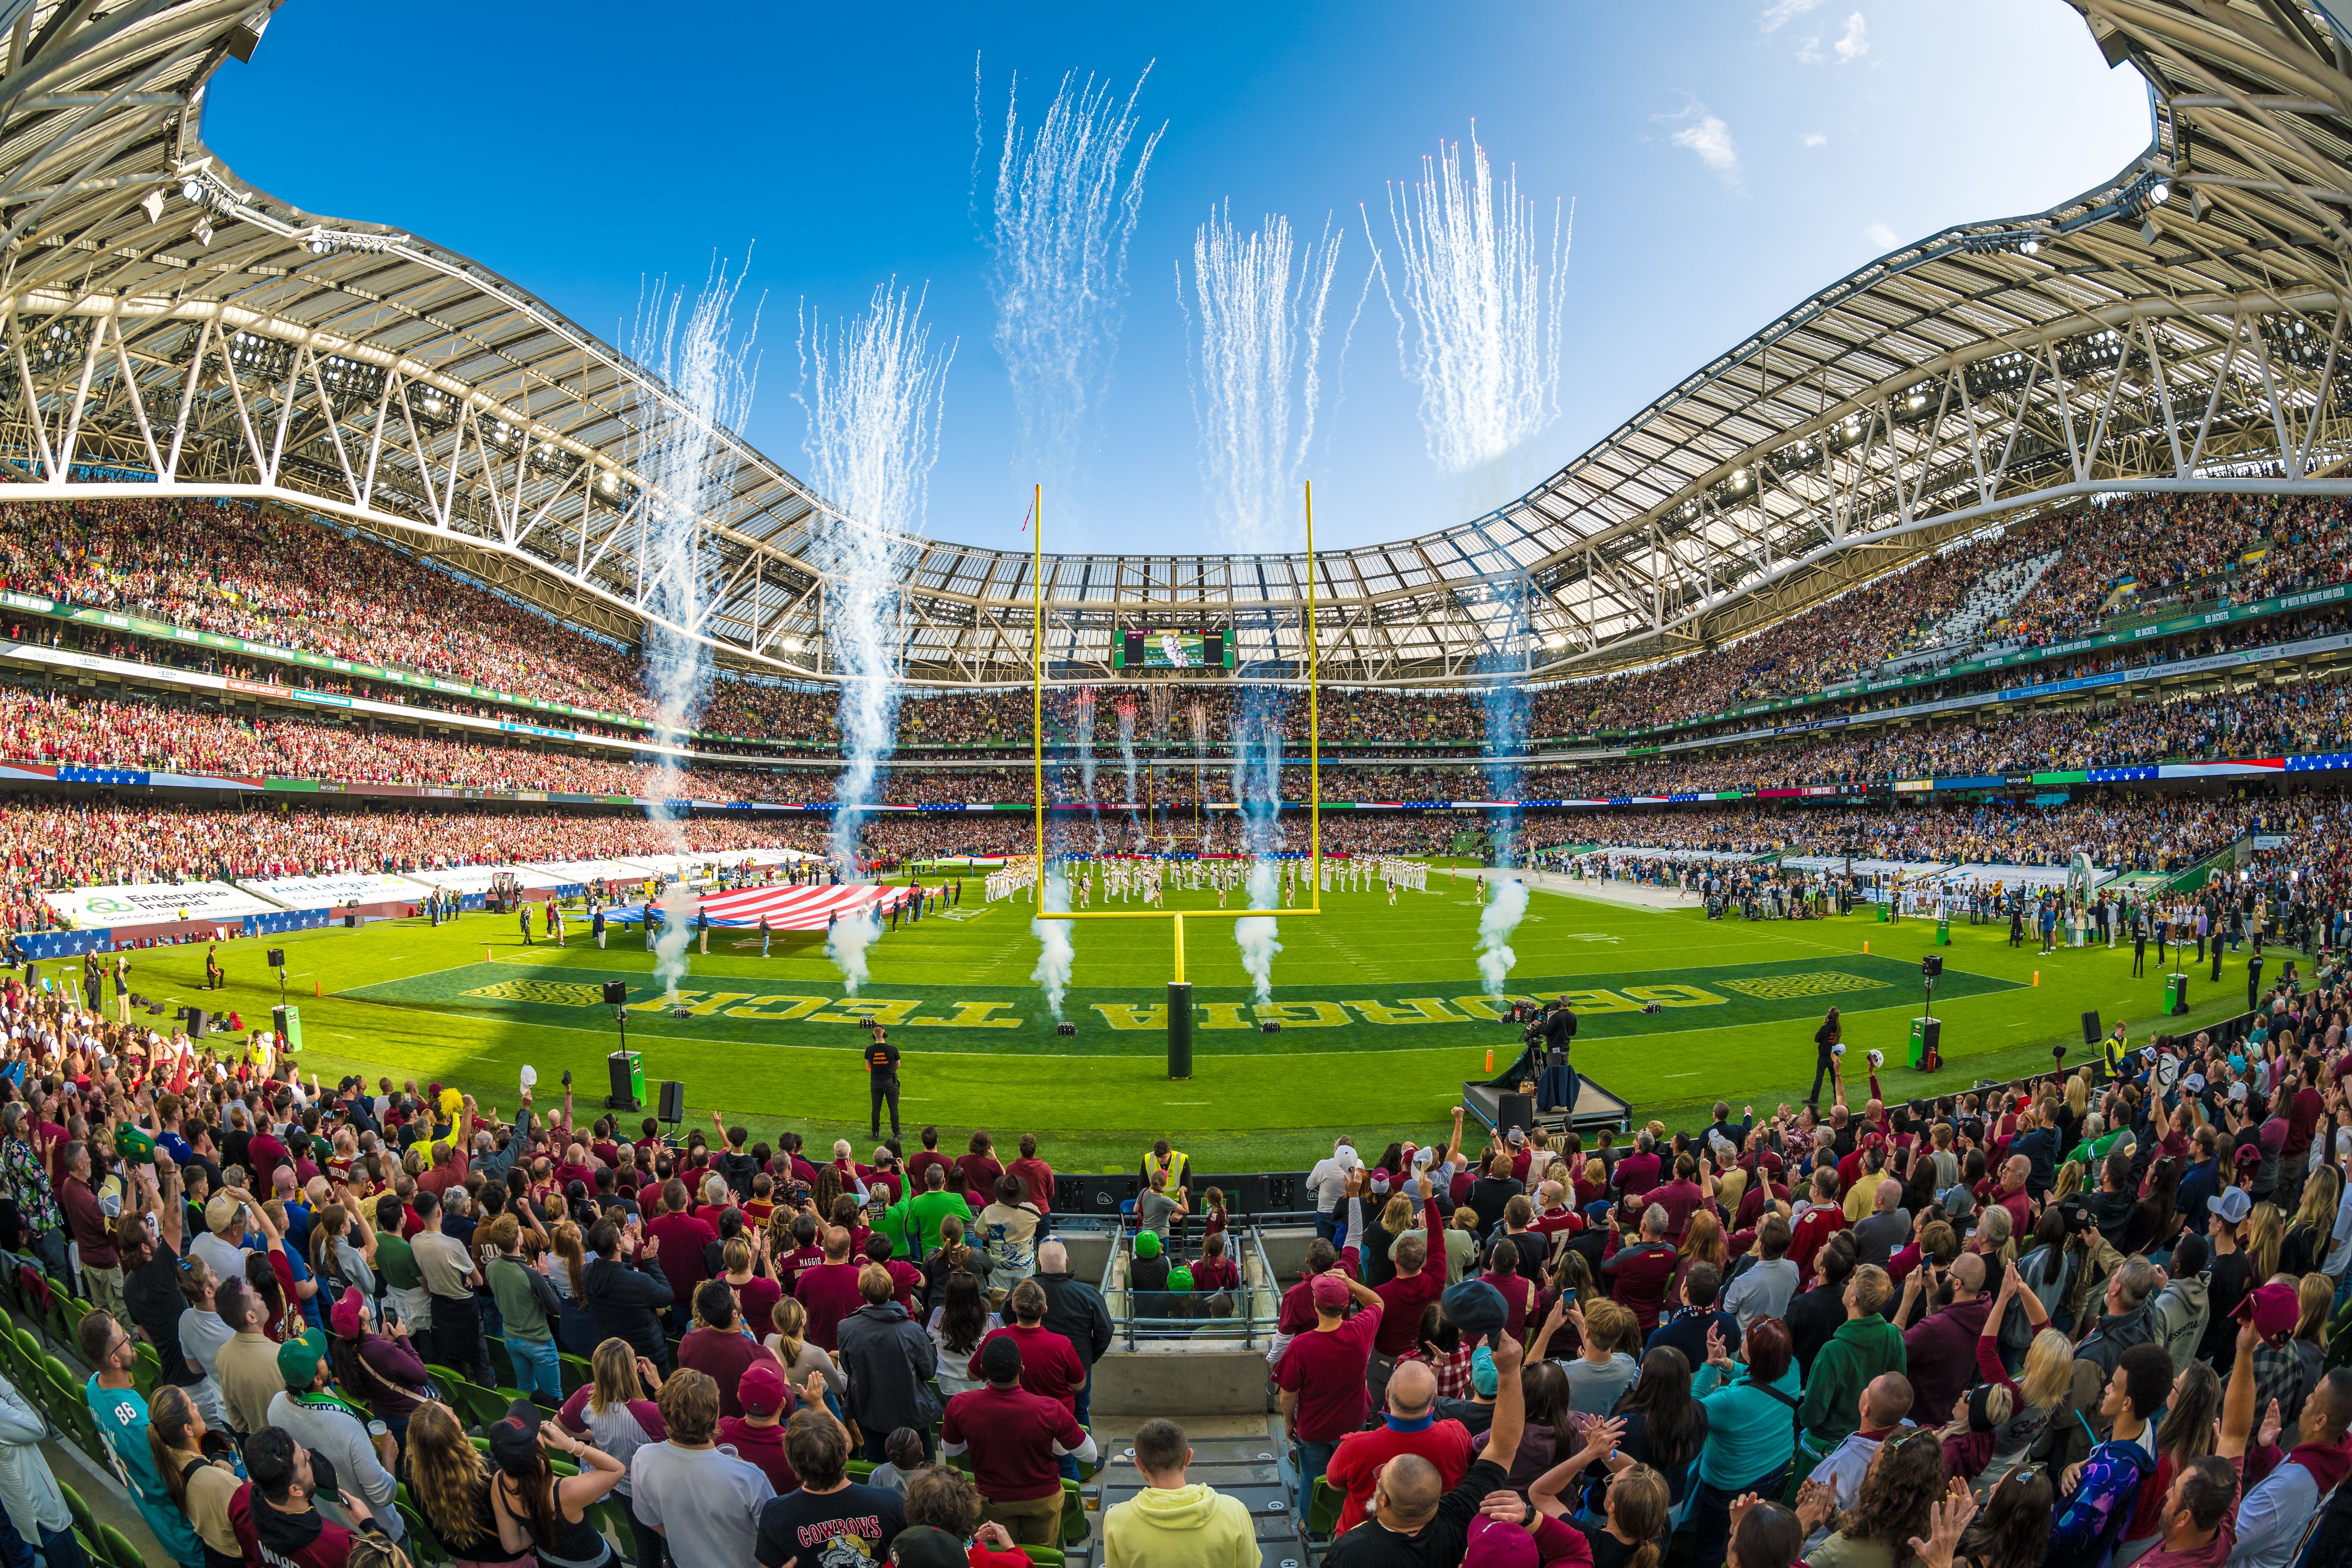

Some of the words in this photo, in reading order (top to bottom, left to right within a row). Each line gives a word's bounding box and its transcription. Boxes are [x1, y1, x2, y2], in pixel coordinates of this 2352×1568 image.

[2281, 598, 2286, 608] UP
[2287, 596, 2299, 607] WITH
[2308, 592, 2322, 603] WHITE
[2323, 590, 2332, 600] AND
[2333, 588, 2344, 599] GOLD
[2205, 614, 2211, 623] GO
[2211, 611, 2229, 622] JACKETS
[2136, 628, 2140, 637] GO
[2141, 626, 2157, 636] JACKETS
[2042, 648, 2046, 656] UP
[2047, 646, 2055, 656] WITH
[2063, 643, 2073, 653] WHITE
[2082, 640, 2091, 649] GOLD
[1990, 658, 2003, 666] JACKETS
[2083, 676, 2114, 686] www.dublincity.ie
[2020, 687, 2049, 697] www.dublin.ie
[1913, 781, 1922, 790] TECH
[428, 788, 442, 797] FLORIDA
[125, 890, 229, 903] Enterprise
[138, 899, 209, 910] Ireland
[1550, 1228, 1569, 1265] 7
[799, 1258, 821, 1266] MAGGIO
[115, 1402, 137, 1426] 86
[798, 1515, 881, 1547] COWBOYS
